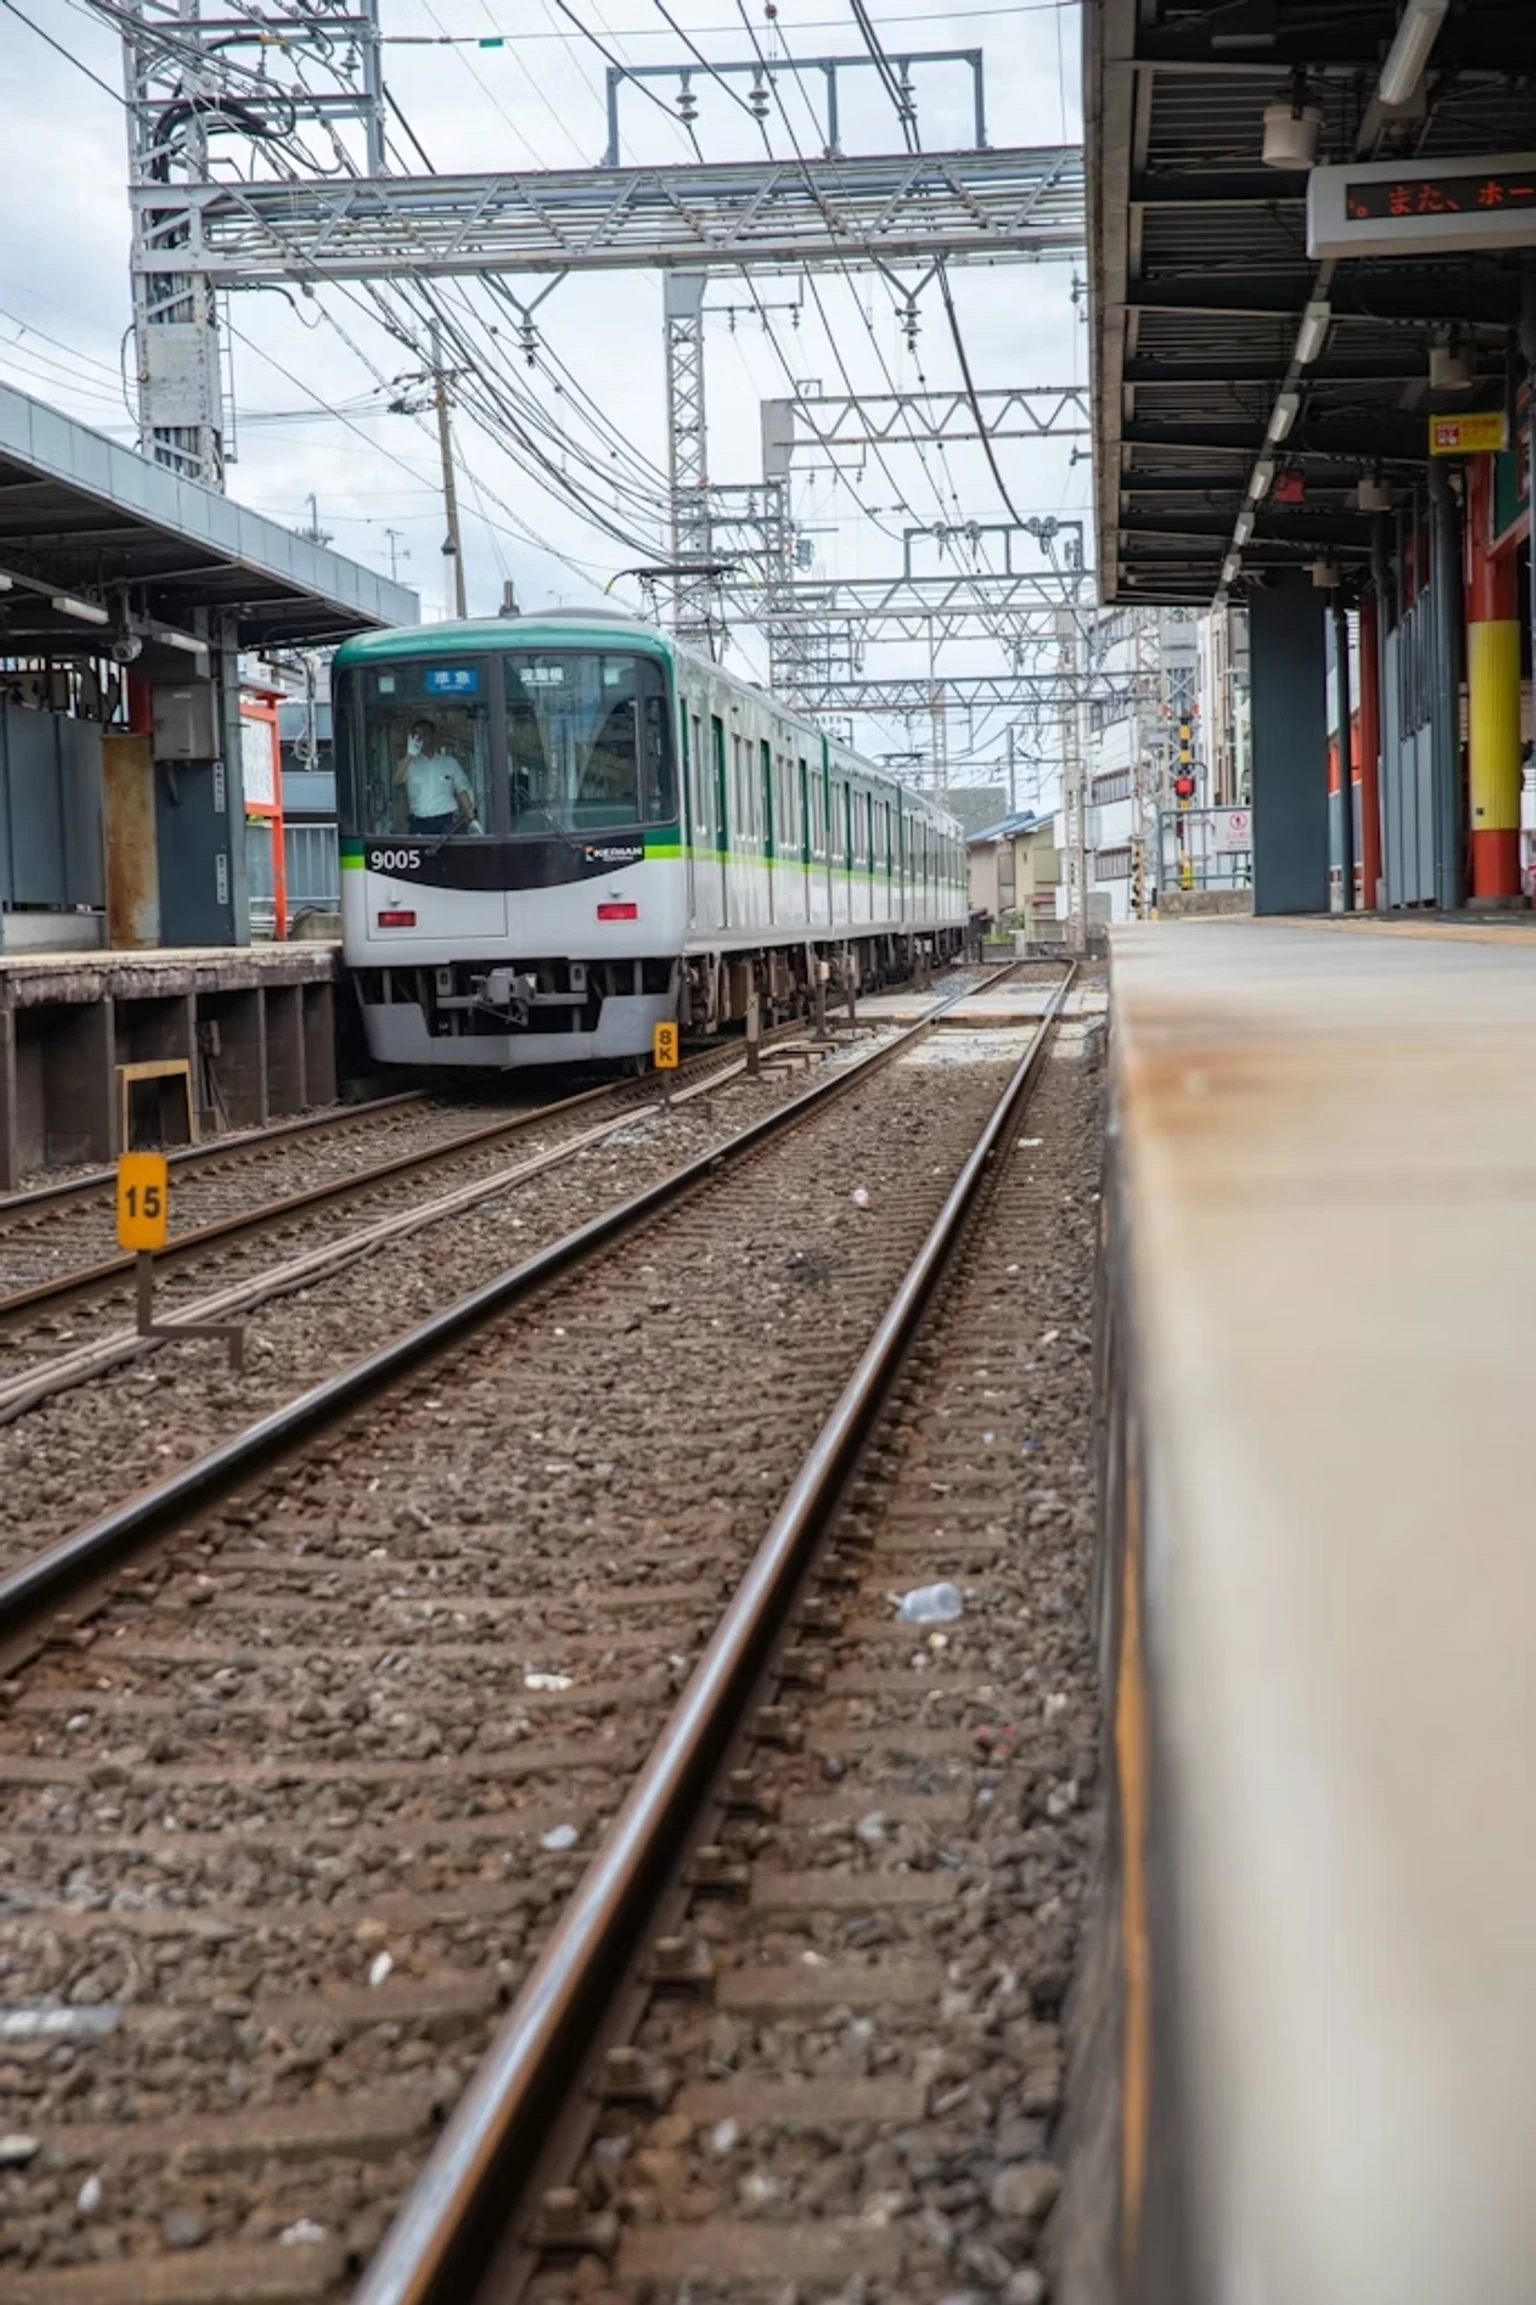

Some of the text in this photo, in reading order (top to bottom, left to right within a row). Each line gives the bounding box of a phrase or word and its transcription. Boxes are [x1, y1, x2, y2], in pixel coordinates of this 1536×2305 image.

[371, 850, 421, 870] 9005
[659, 1029, 672, 1045] 8
[659, 1046, 673, 1061] K
[125, 1184, 161, 1218] 15
